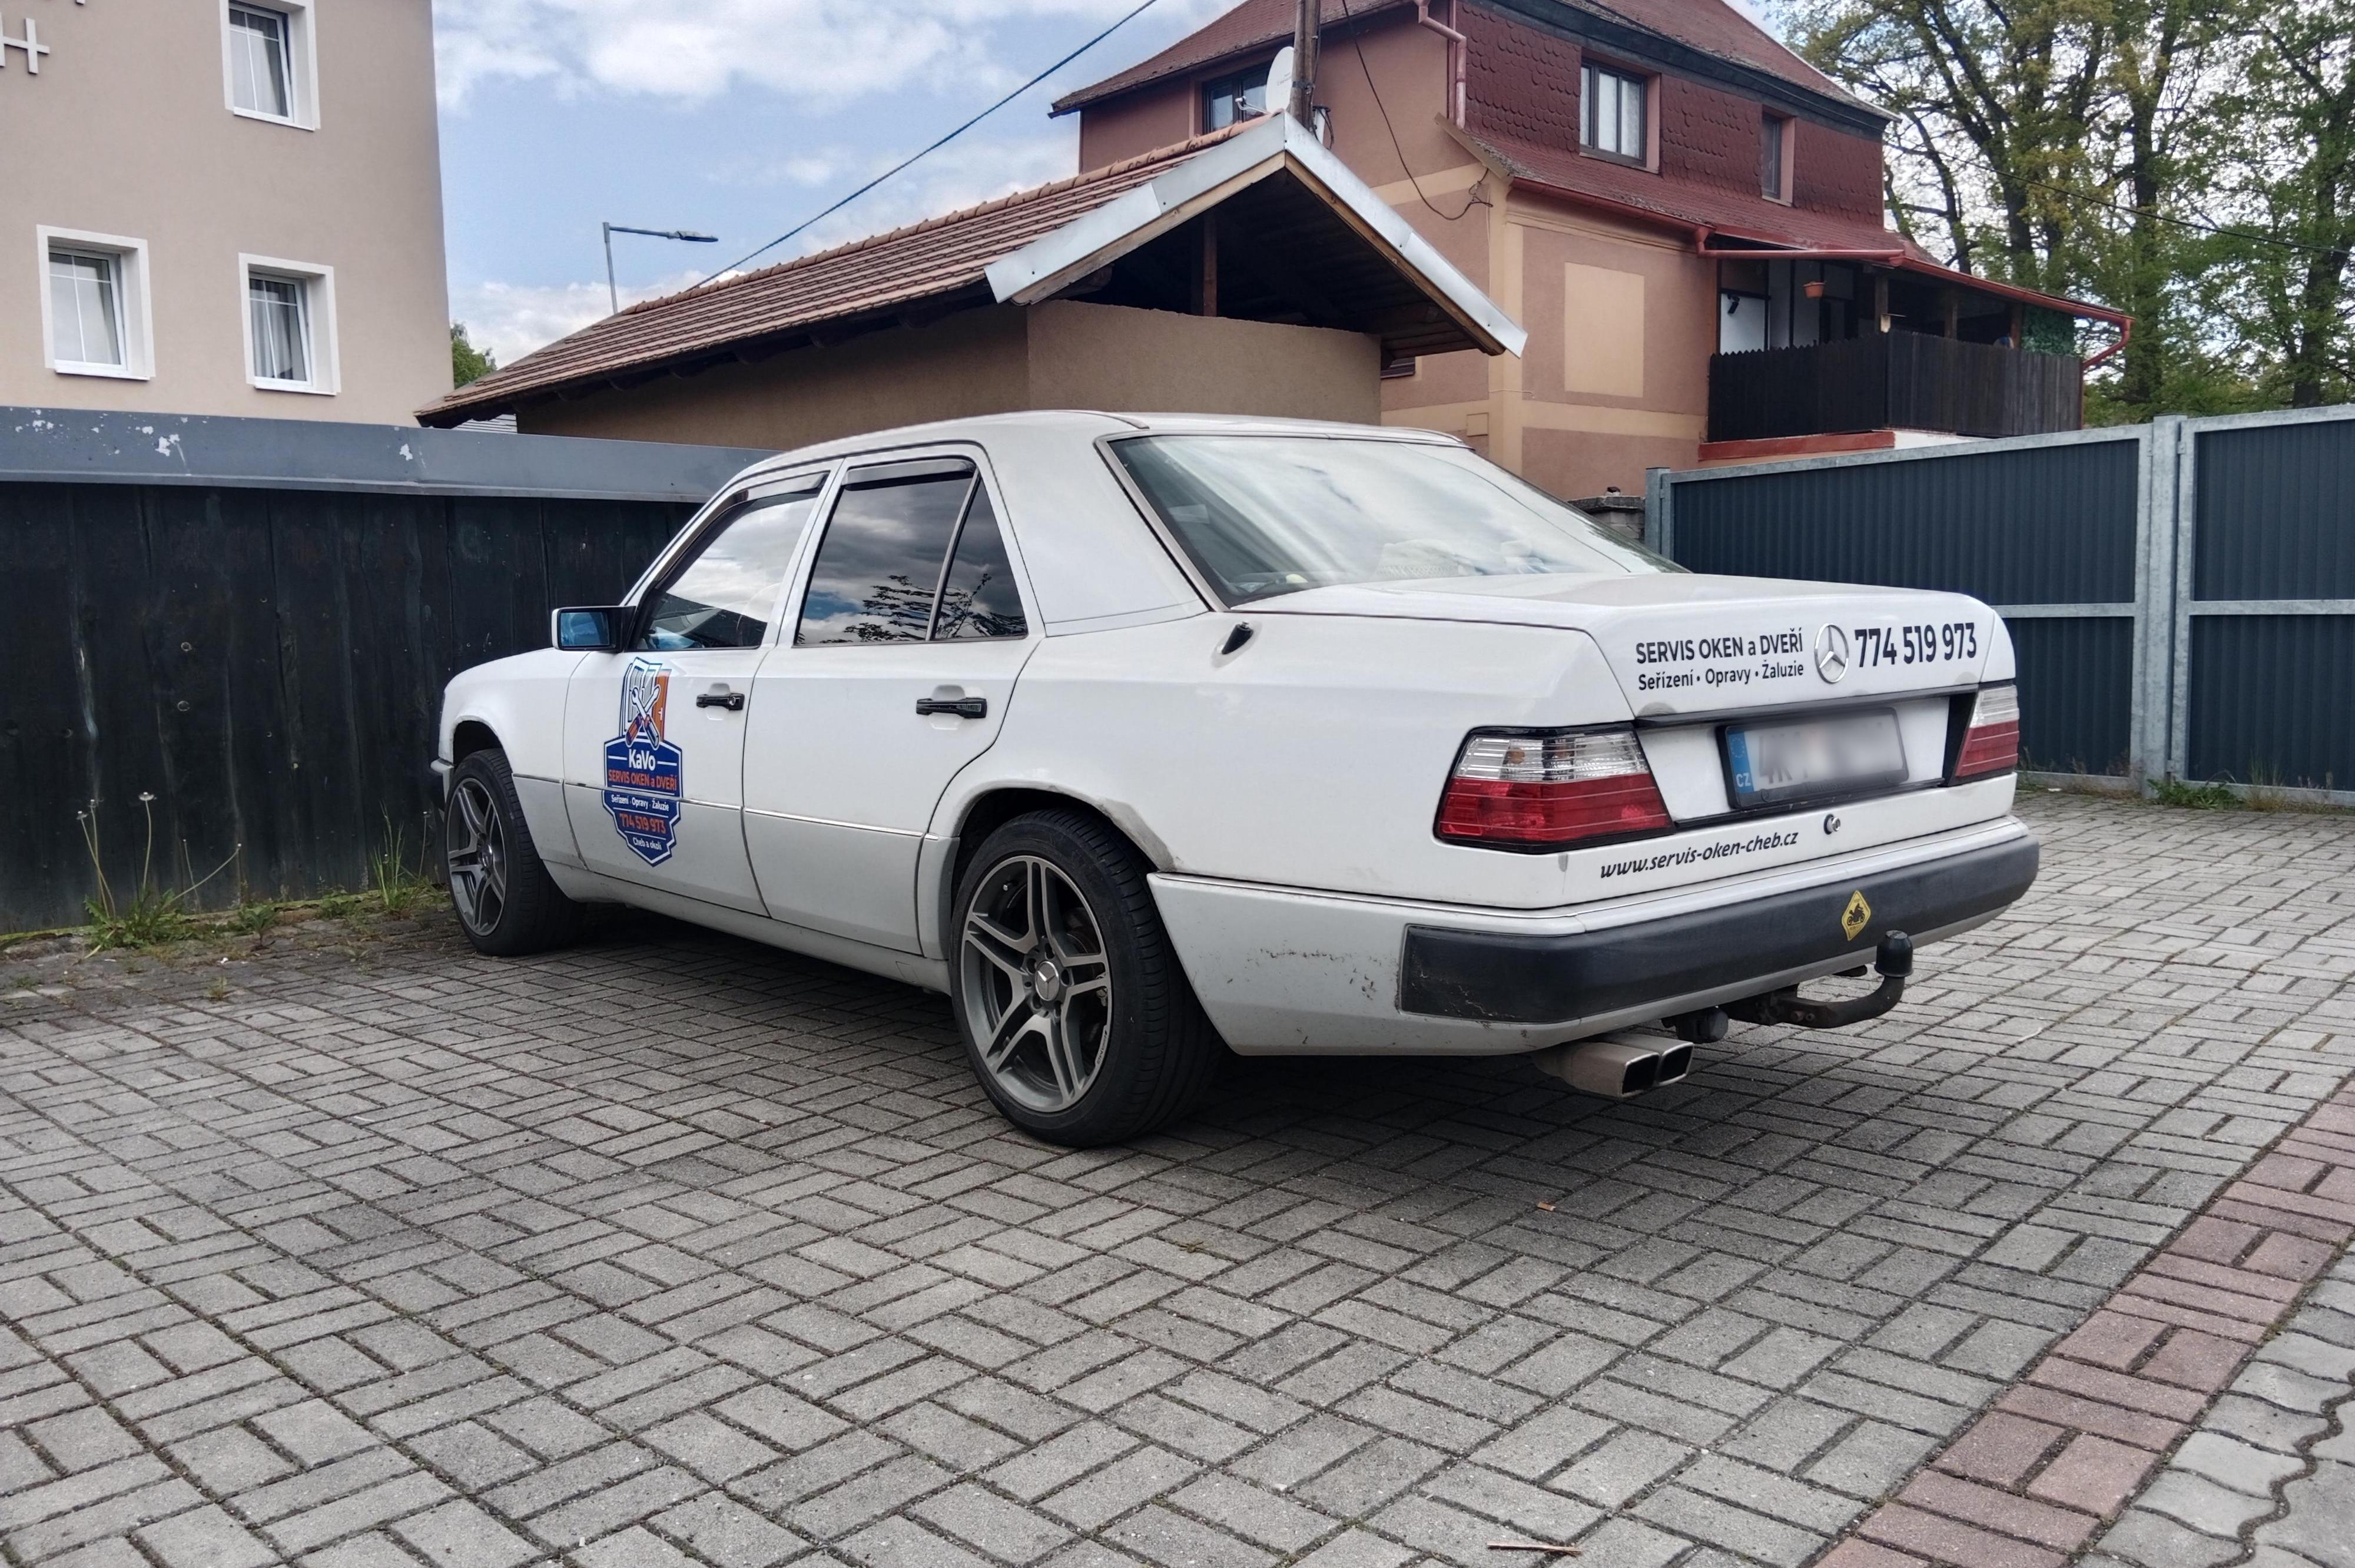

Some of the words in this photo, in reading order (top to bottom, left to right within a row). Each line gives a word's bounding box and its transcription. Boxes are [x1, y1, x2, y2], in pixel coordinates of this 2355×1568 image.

[1636, 639, 1694, 664] SERVIS
[1699, 637, 1743, 659] OKEN
[1748, 640, 1756, 655] a
[1760, 627, 1803, 655] DVEŘÍ
[1855, 628, 1897, 667] 774
[1903, 624, 1936, 664] 519
[1942, 622, 1976, 661] 973
[1638, 669, 1694, 691] Seřízení
[1705, 668, 1750, 687] Opravy
[1762, 659, 1804, 679] Žaluzie
[629, 748, 656, 771] KaVo
[608, 769, 630, 784] SERVIS
[631, 773, 649, 787] OKEN
[651, 778, 655, 787] a
[656, 774, 677, 791] DVEŘÍ
[1736, 773, 1751, 787] CZ
[632, 797, 648, 810] Opravy
[652, 798, 669, 811] Žaluzie
[619, 813, 635, 828] 774
[636, 816, 649, 831] 519
[650, 818, 666, 834] 973
[1600, 831, 1799, 879] www.servis-oken-cheb.cz
